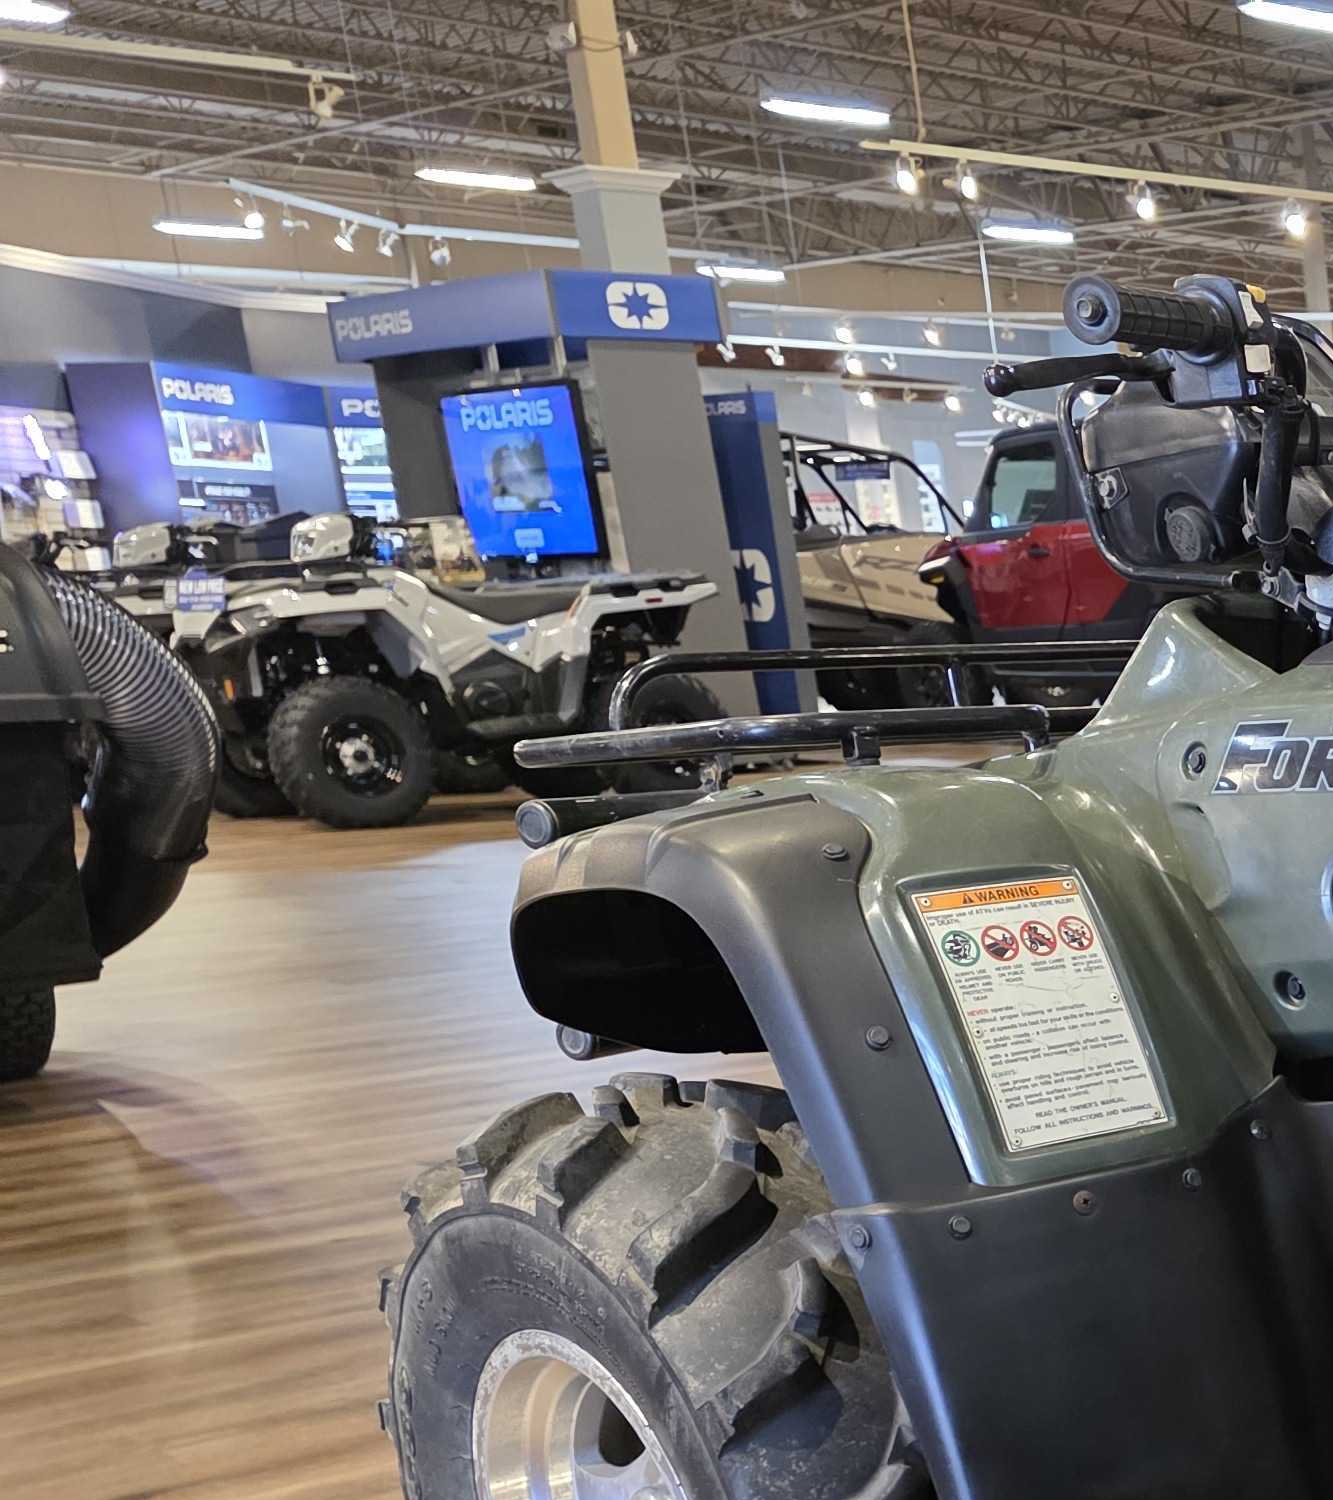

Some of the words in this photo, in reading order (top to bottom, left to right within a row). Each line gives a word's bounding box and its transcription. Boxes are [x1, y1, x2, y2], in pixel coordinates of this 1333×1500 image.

[335, 309, 413, 342] POLARIS
[161, 377, 235, 405] POLARIS
[460, 399, 554, 432] POLARIS
[974, 885, 1040, 902] WARNING
